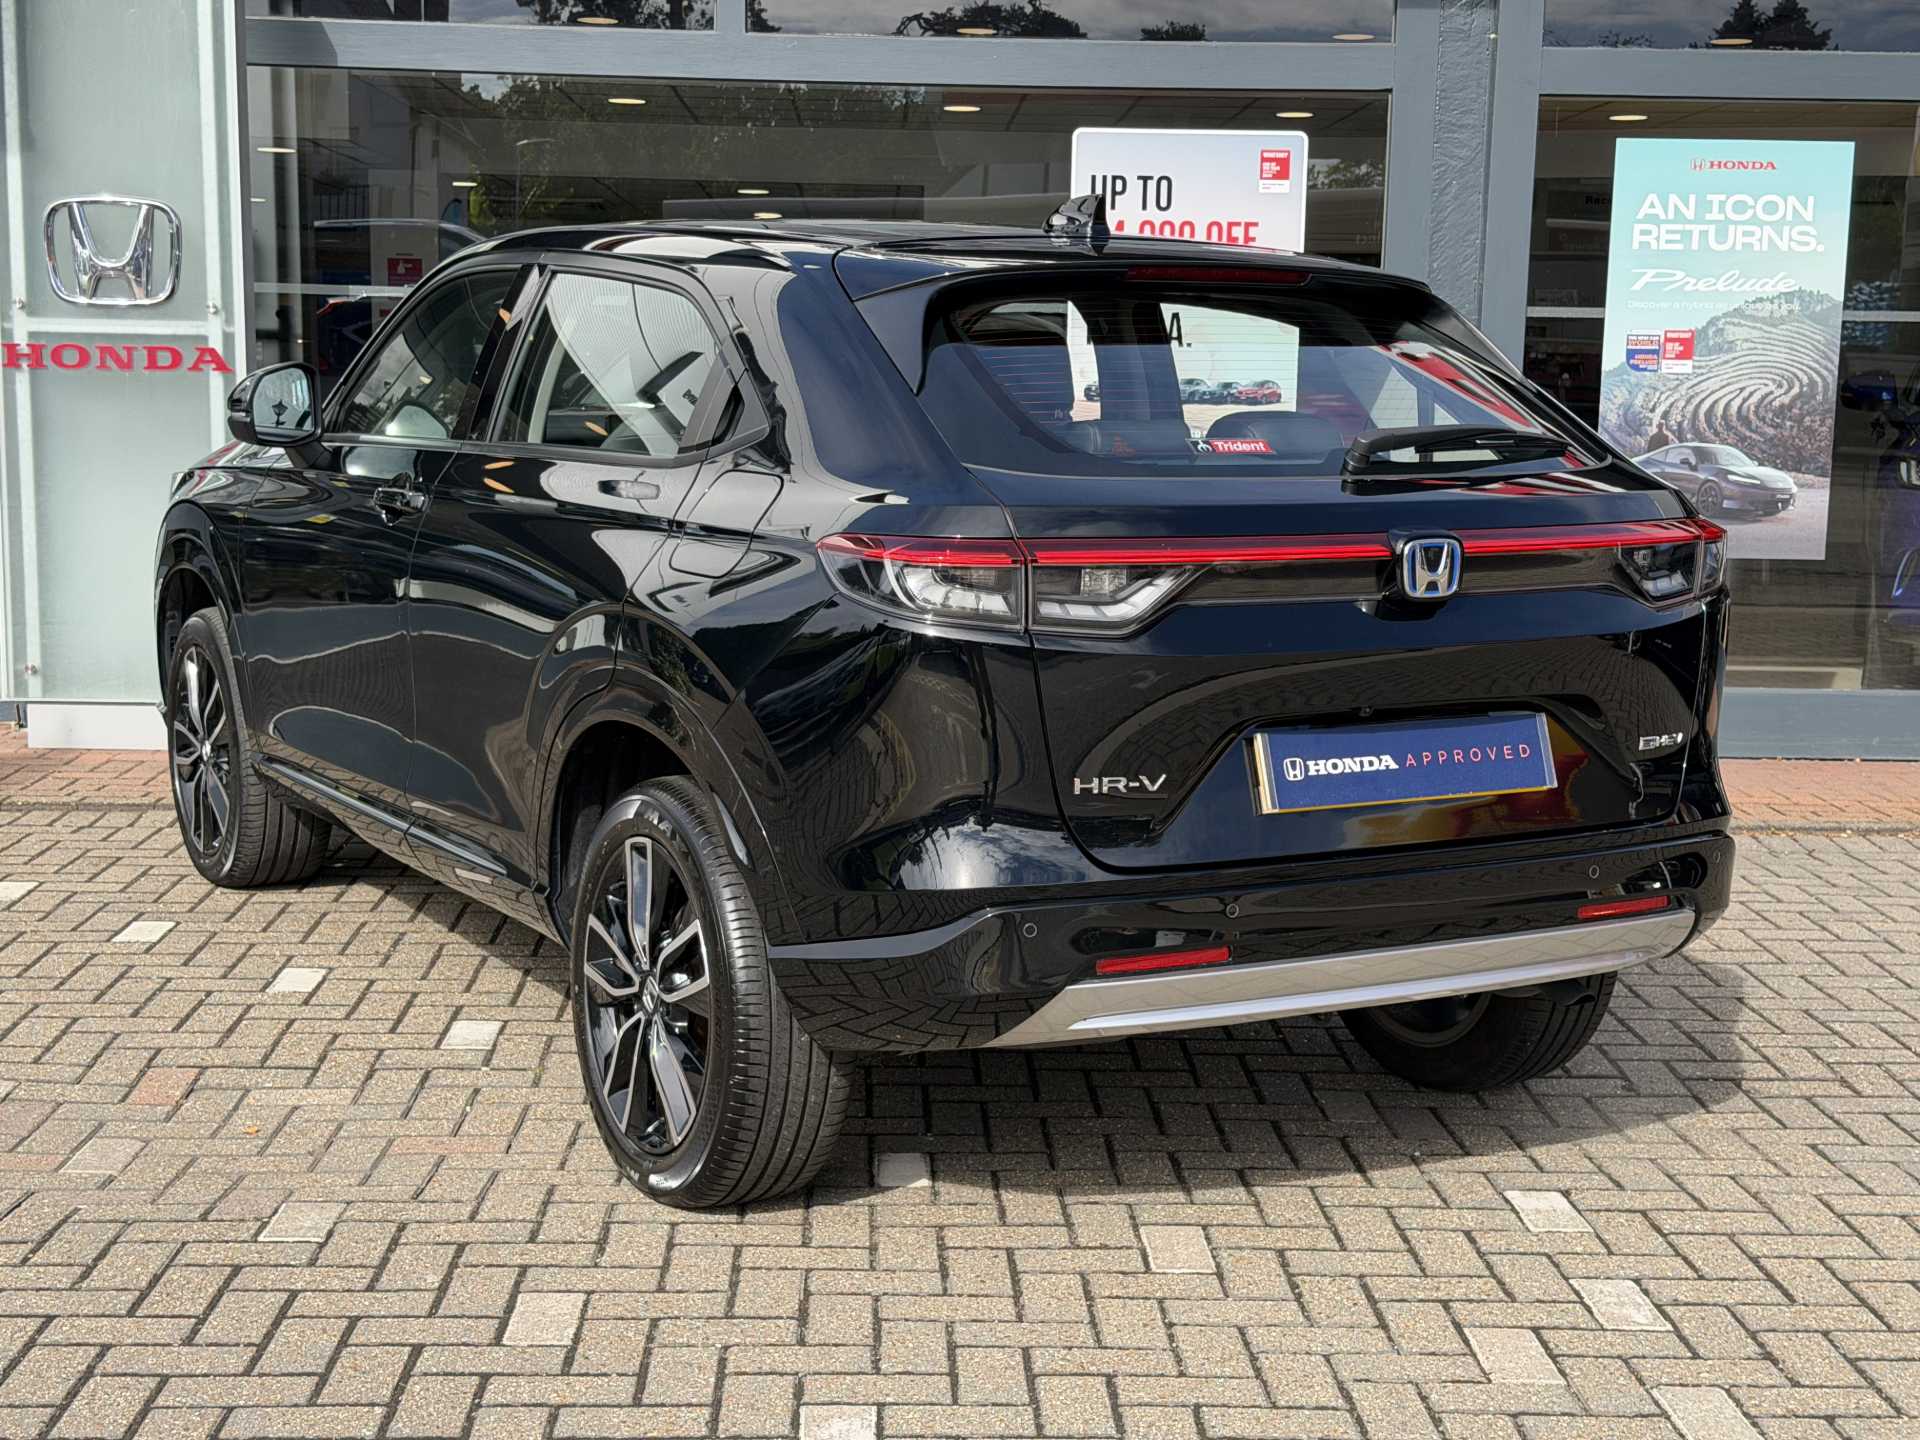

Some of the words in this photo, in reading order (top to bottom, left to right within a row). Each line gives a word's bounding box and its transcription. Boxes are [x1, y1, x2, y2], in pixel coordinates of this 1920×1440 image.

[1708, 160, 1777, 171] HONDA
[1090, 174, 1128, 211] UP
[1136, 175, 1173, 212] TO
[1635, 192, 1697, 221] AN
[1704, 193, 1815, 222] ICON
[1631, 223, 1825, 252] RETURNS.
[1630, 268, 1800, 293] Prelude
[1, 342, 234, 374] HONDA
[1214, 440, 1267, 452] Trident
[1307, 754, 1399, 776] HONDA
[1405, 743, 1531, 768] APPROVED
[1073, 773, 1167, 795] HR-V
